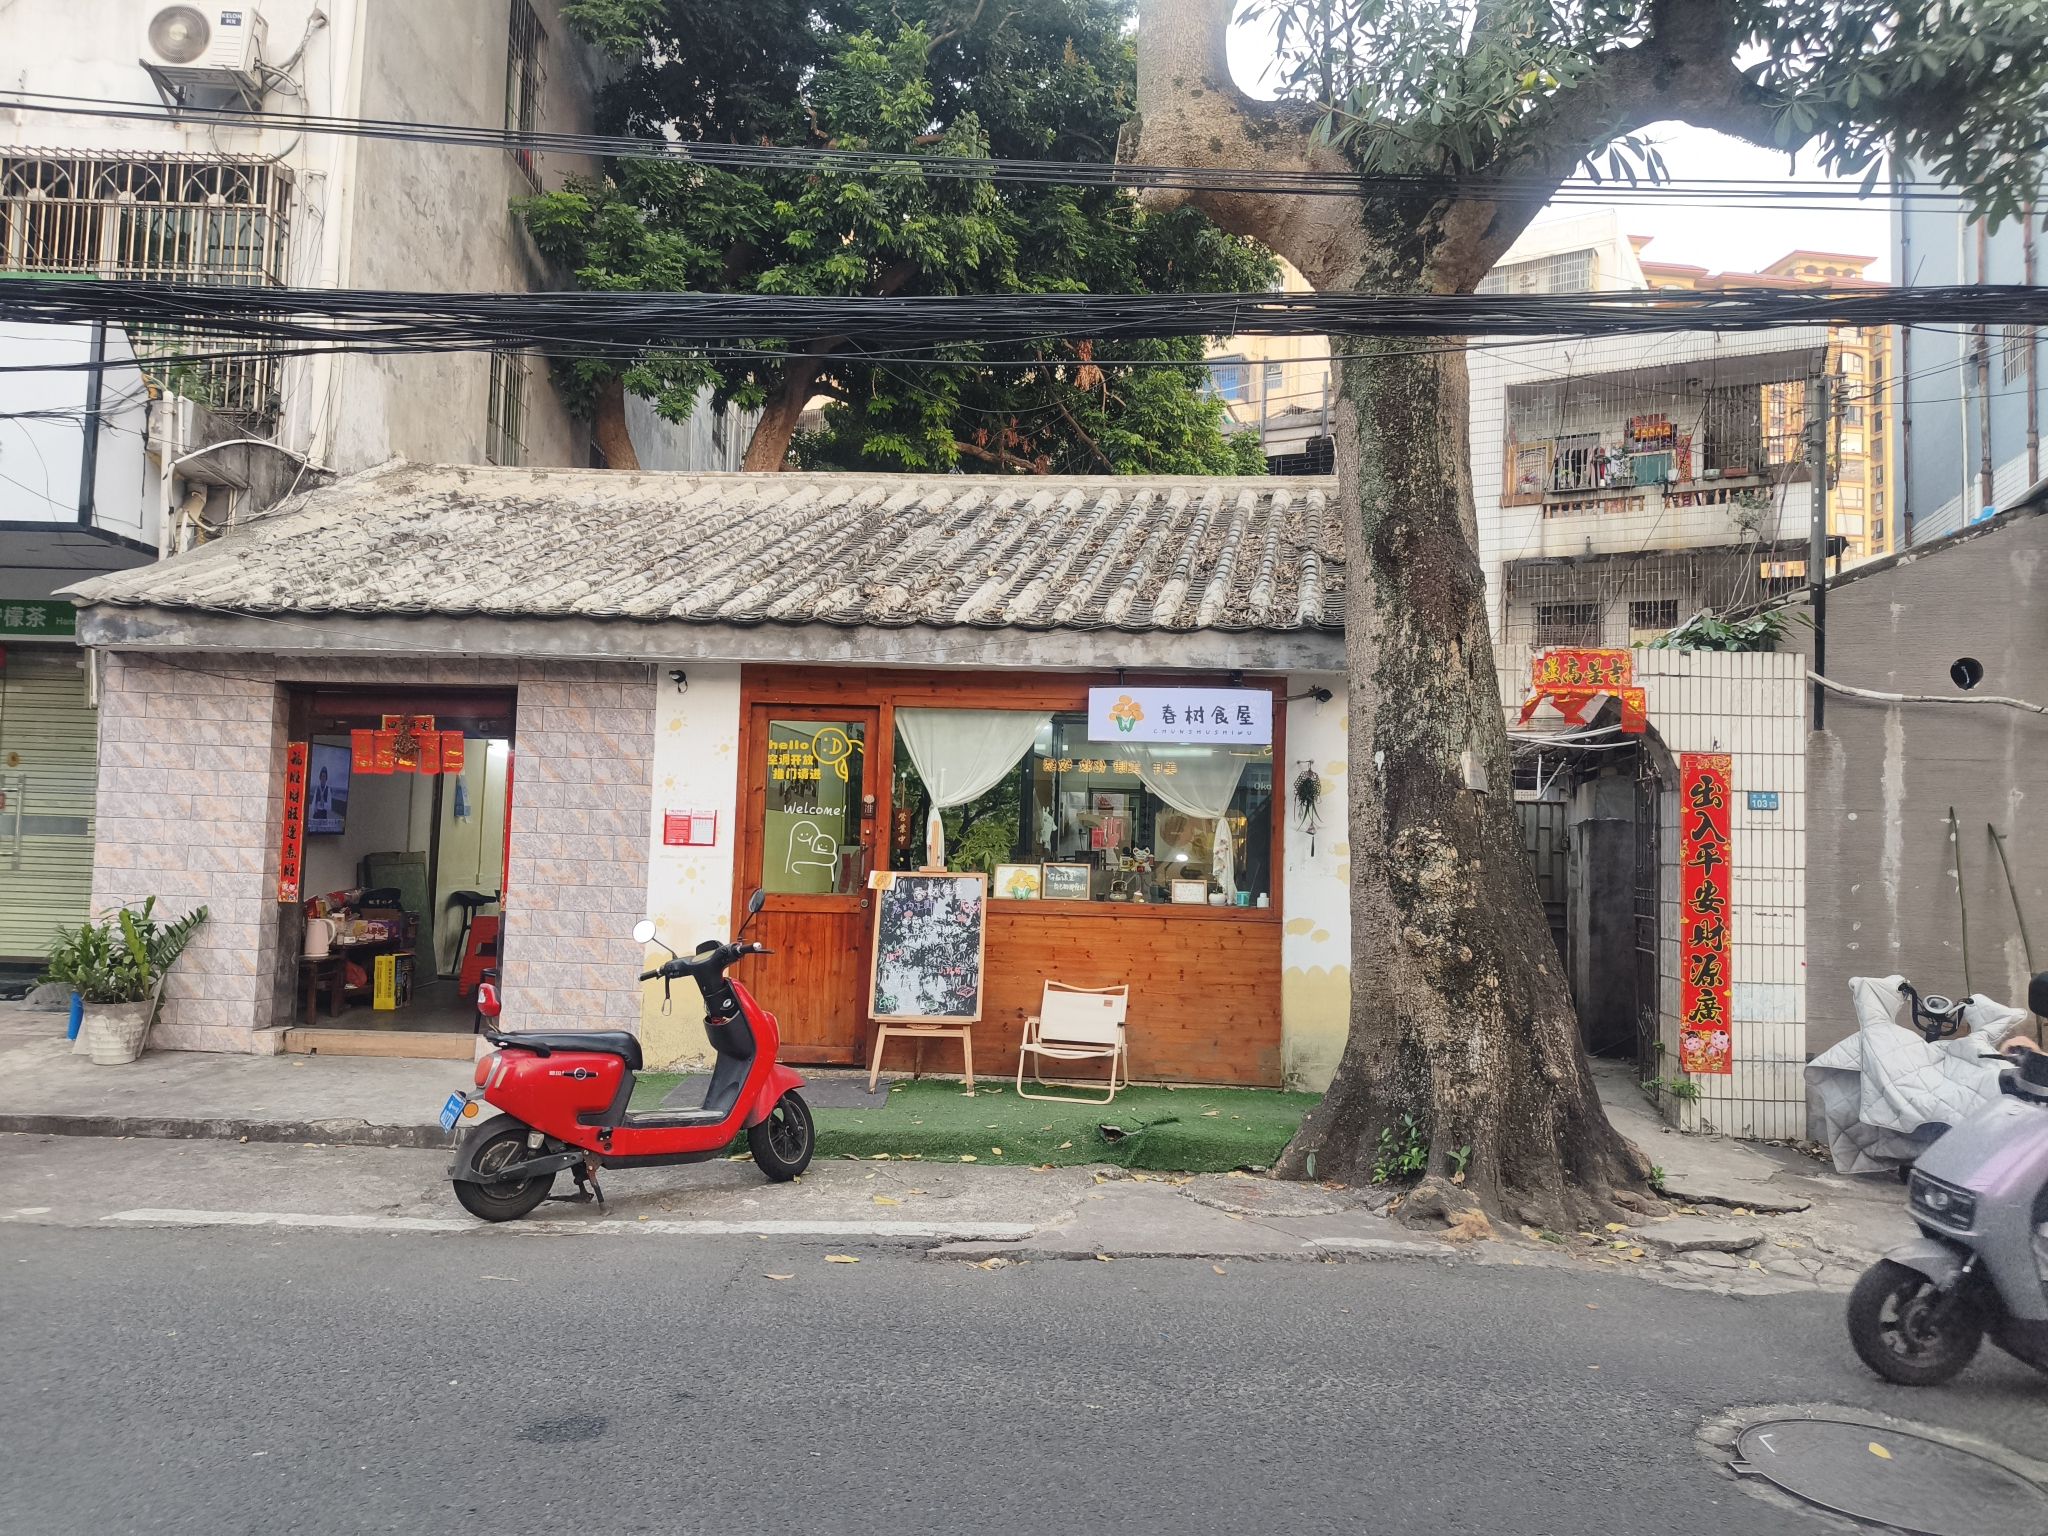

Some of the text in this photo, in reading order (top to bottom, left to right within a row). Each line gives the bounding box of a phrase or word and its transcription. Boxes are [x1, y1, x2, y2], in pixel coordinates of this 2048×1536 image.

[0, 606, 47, 628] 檬茶
[1161, 704, 1254, 726] 春树食屋
[769, 739, 810, 750] hello
[768, 754, 814, 766] 空调开放
[772, 767, 821, 780] 推门请进
[783, 802, 847, 818] Welcome!
[1751, 799, 1768, 808] 103
[1687, 774, 1726, 1025] 出入平安財源廣
